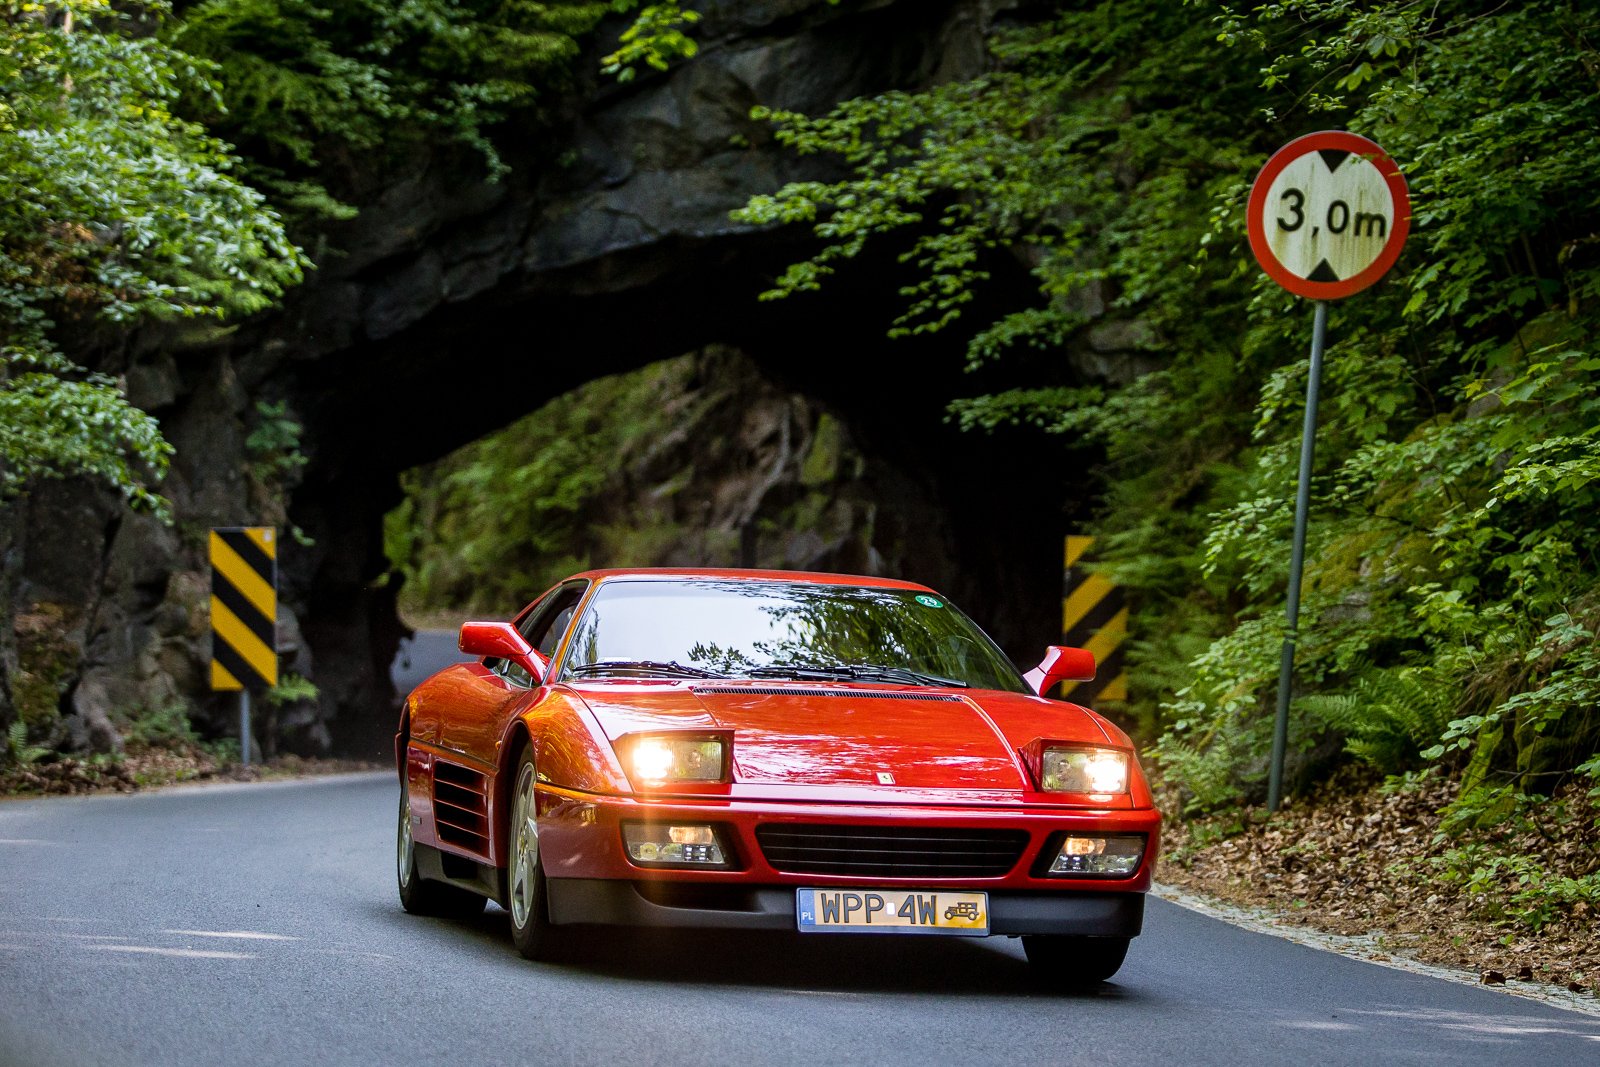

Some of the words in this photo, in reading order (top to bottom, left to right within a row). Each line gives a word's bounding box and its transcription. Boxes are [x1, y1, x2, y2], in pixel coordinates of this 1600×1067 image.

[802, 911, 814, 921] PL
[821, 893, 885, 923] WPP
[898, 895, 936, 925] 4W
